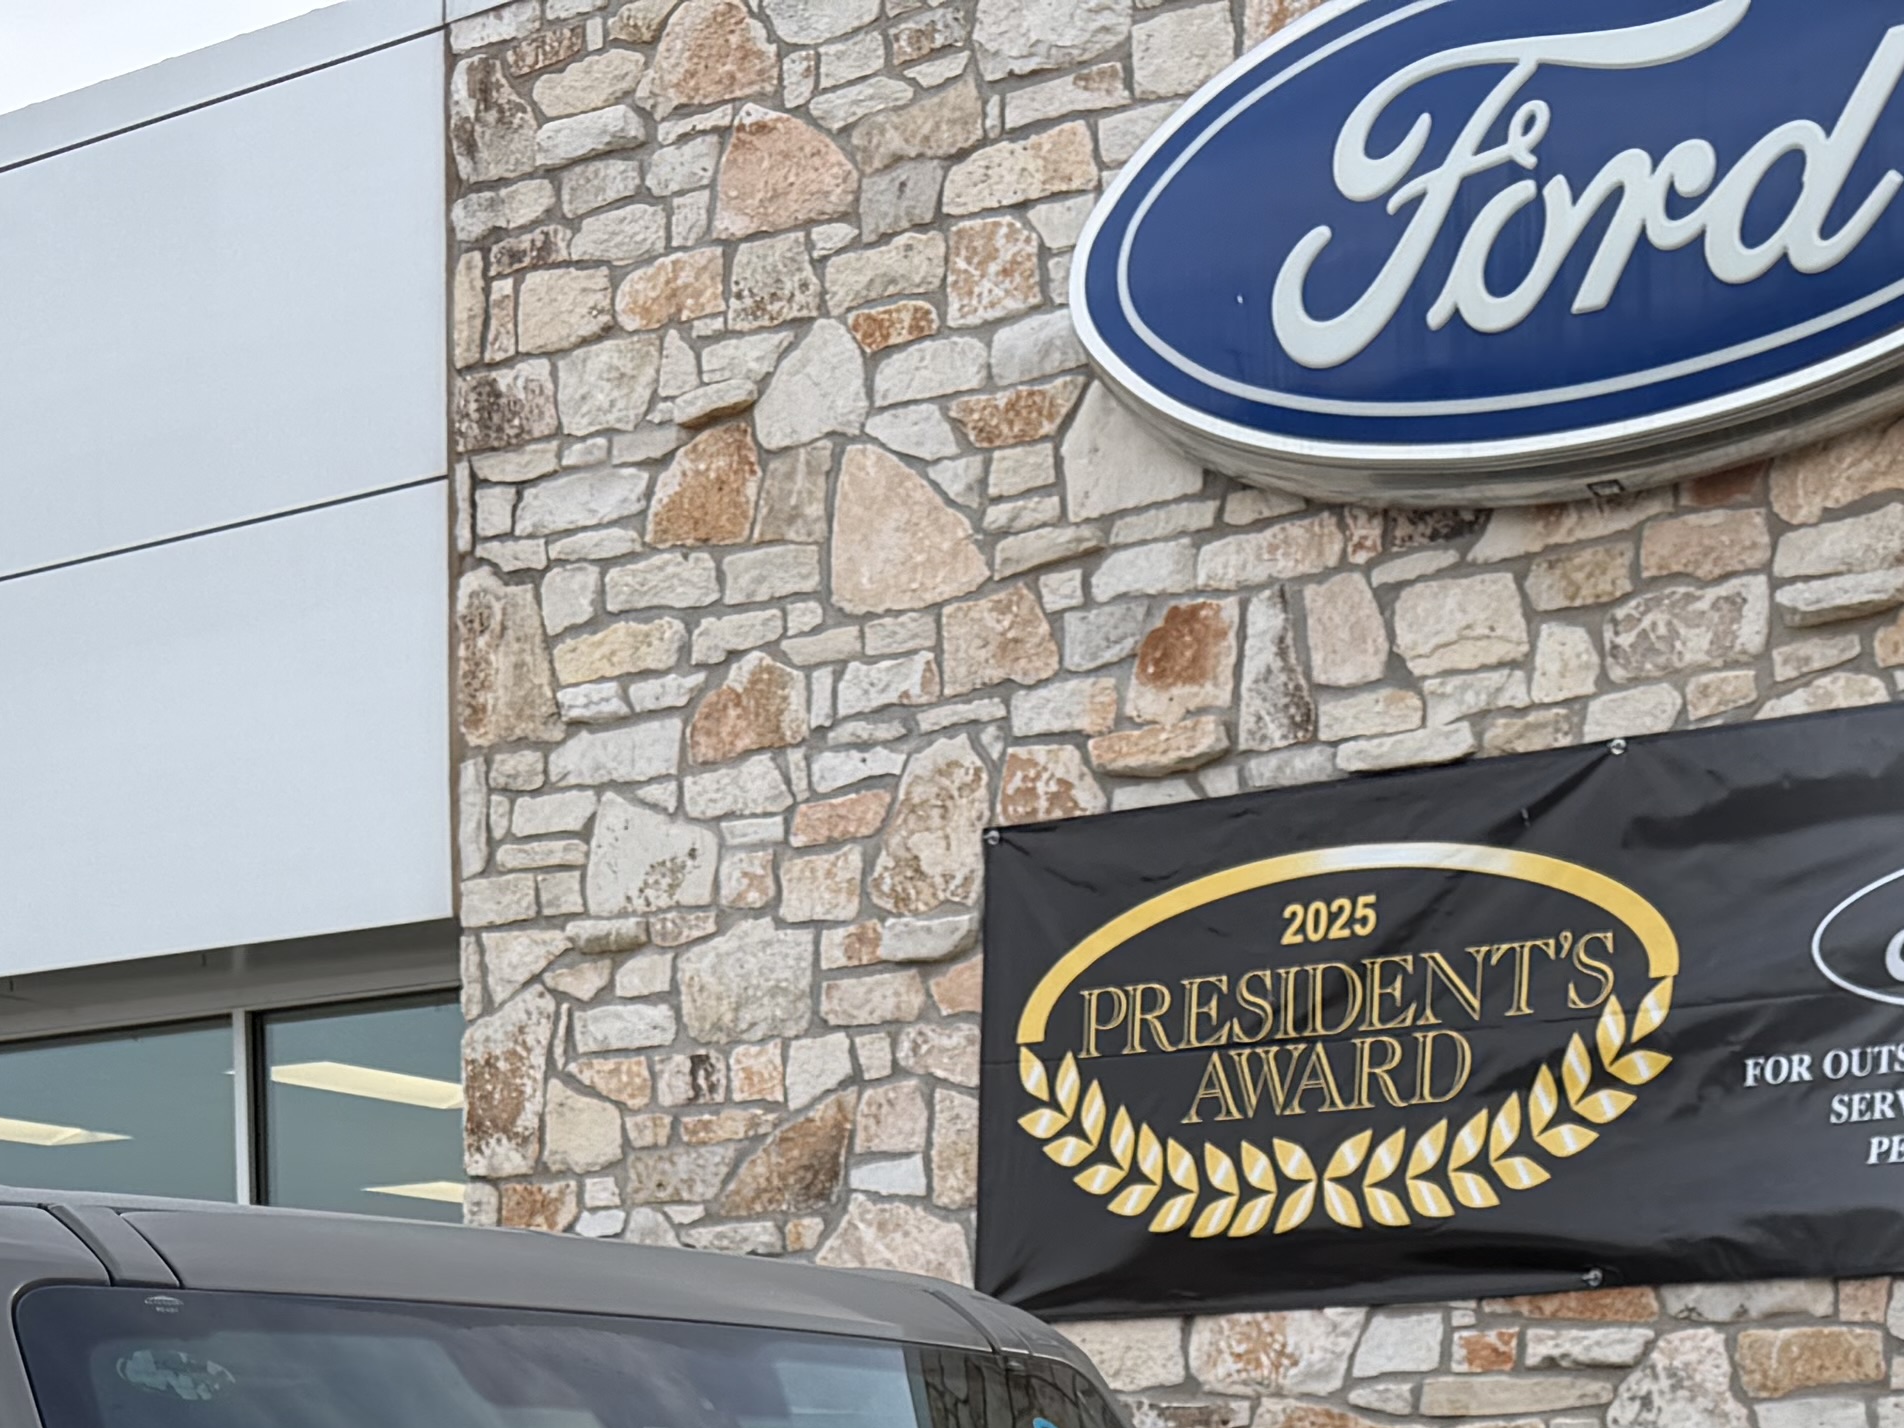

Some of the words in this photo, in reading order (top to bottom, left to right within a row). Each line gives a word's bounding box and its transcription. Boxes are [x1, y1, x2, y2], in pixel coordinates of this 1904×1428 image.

[1280, 893, 1378, 946] 2025
[1077, 928, 1616, 1060] PRESIDENT'S
[1179, 1029, 1473, 1124] AWARD
[1743, 1054, 1813, 1088] FOR
